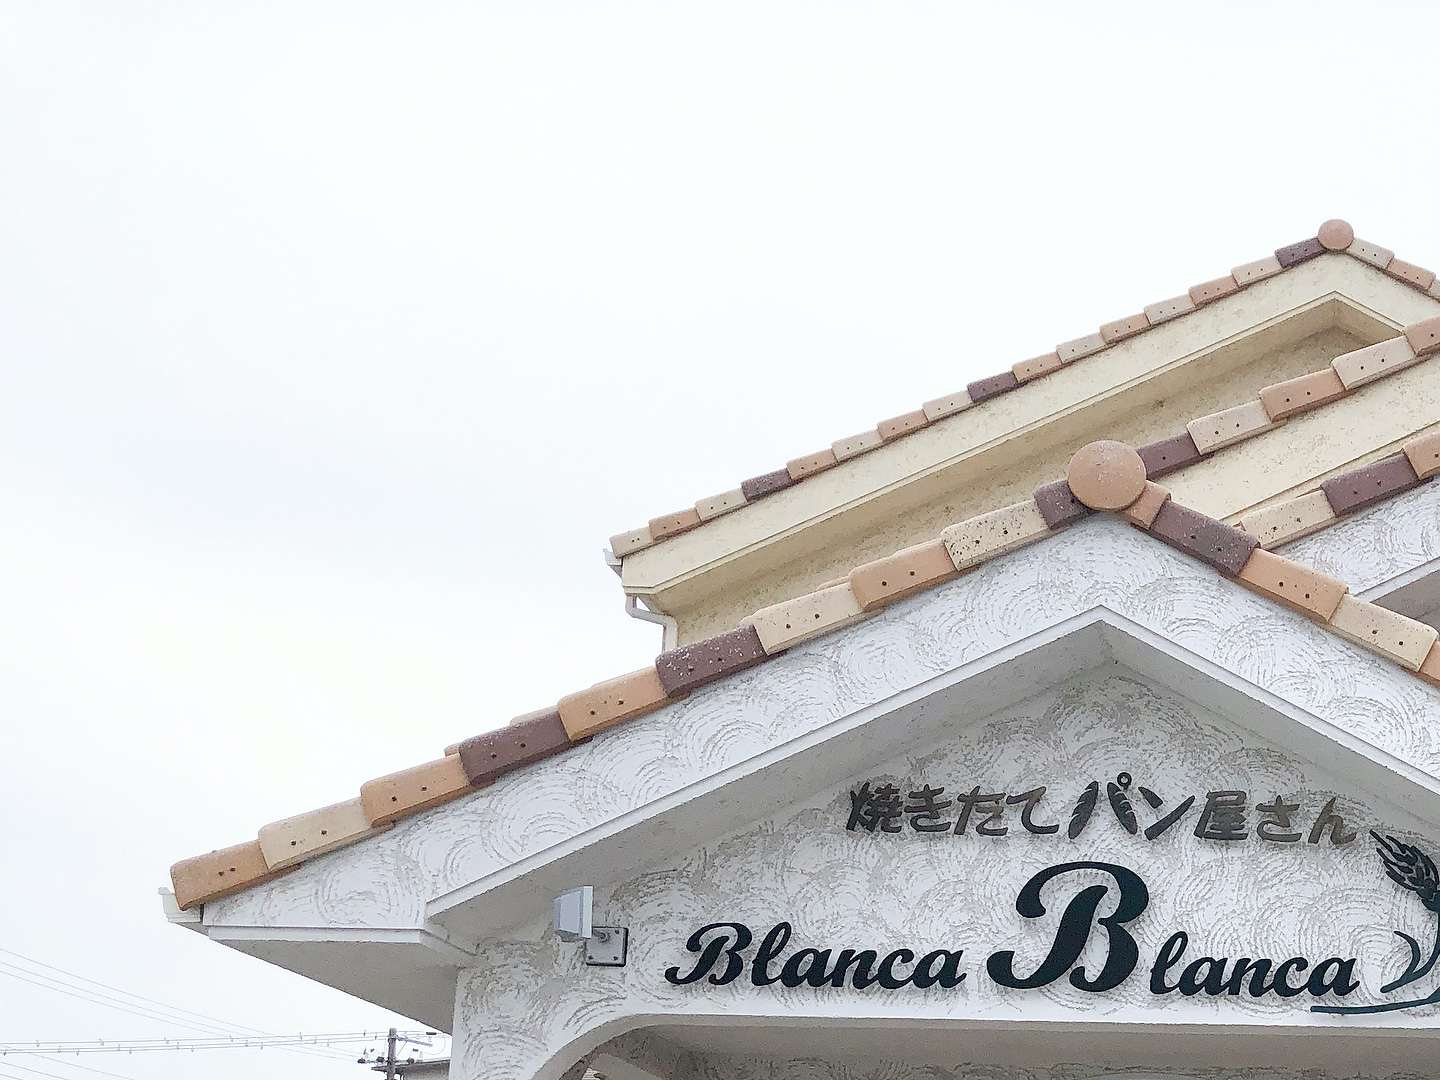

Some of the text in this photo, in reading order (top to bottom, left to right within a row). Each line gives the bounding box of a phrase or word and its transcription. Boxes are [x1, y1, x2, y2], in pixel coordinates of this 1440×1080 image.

[844, 771, 1358, 850] 焼きたてパン屋さん
[664, 921, 968, 991] Blanca
